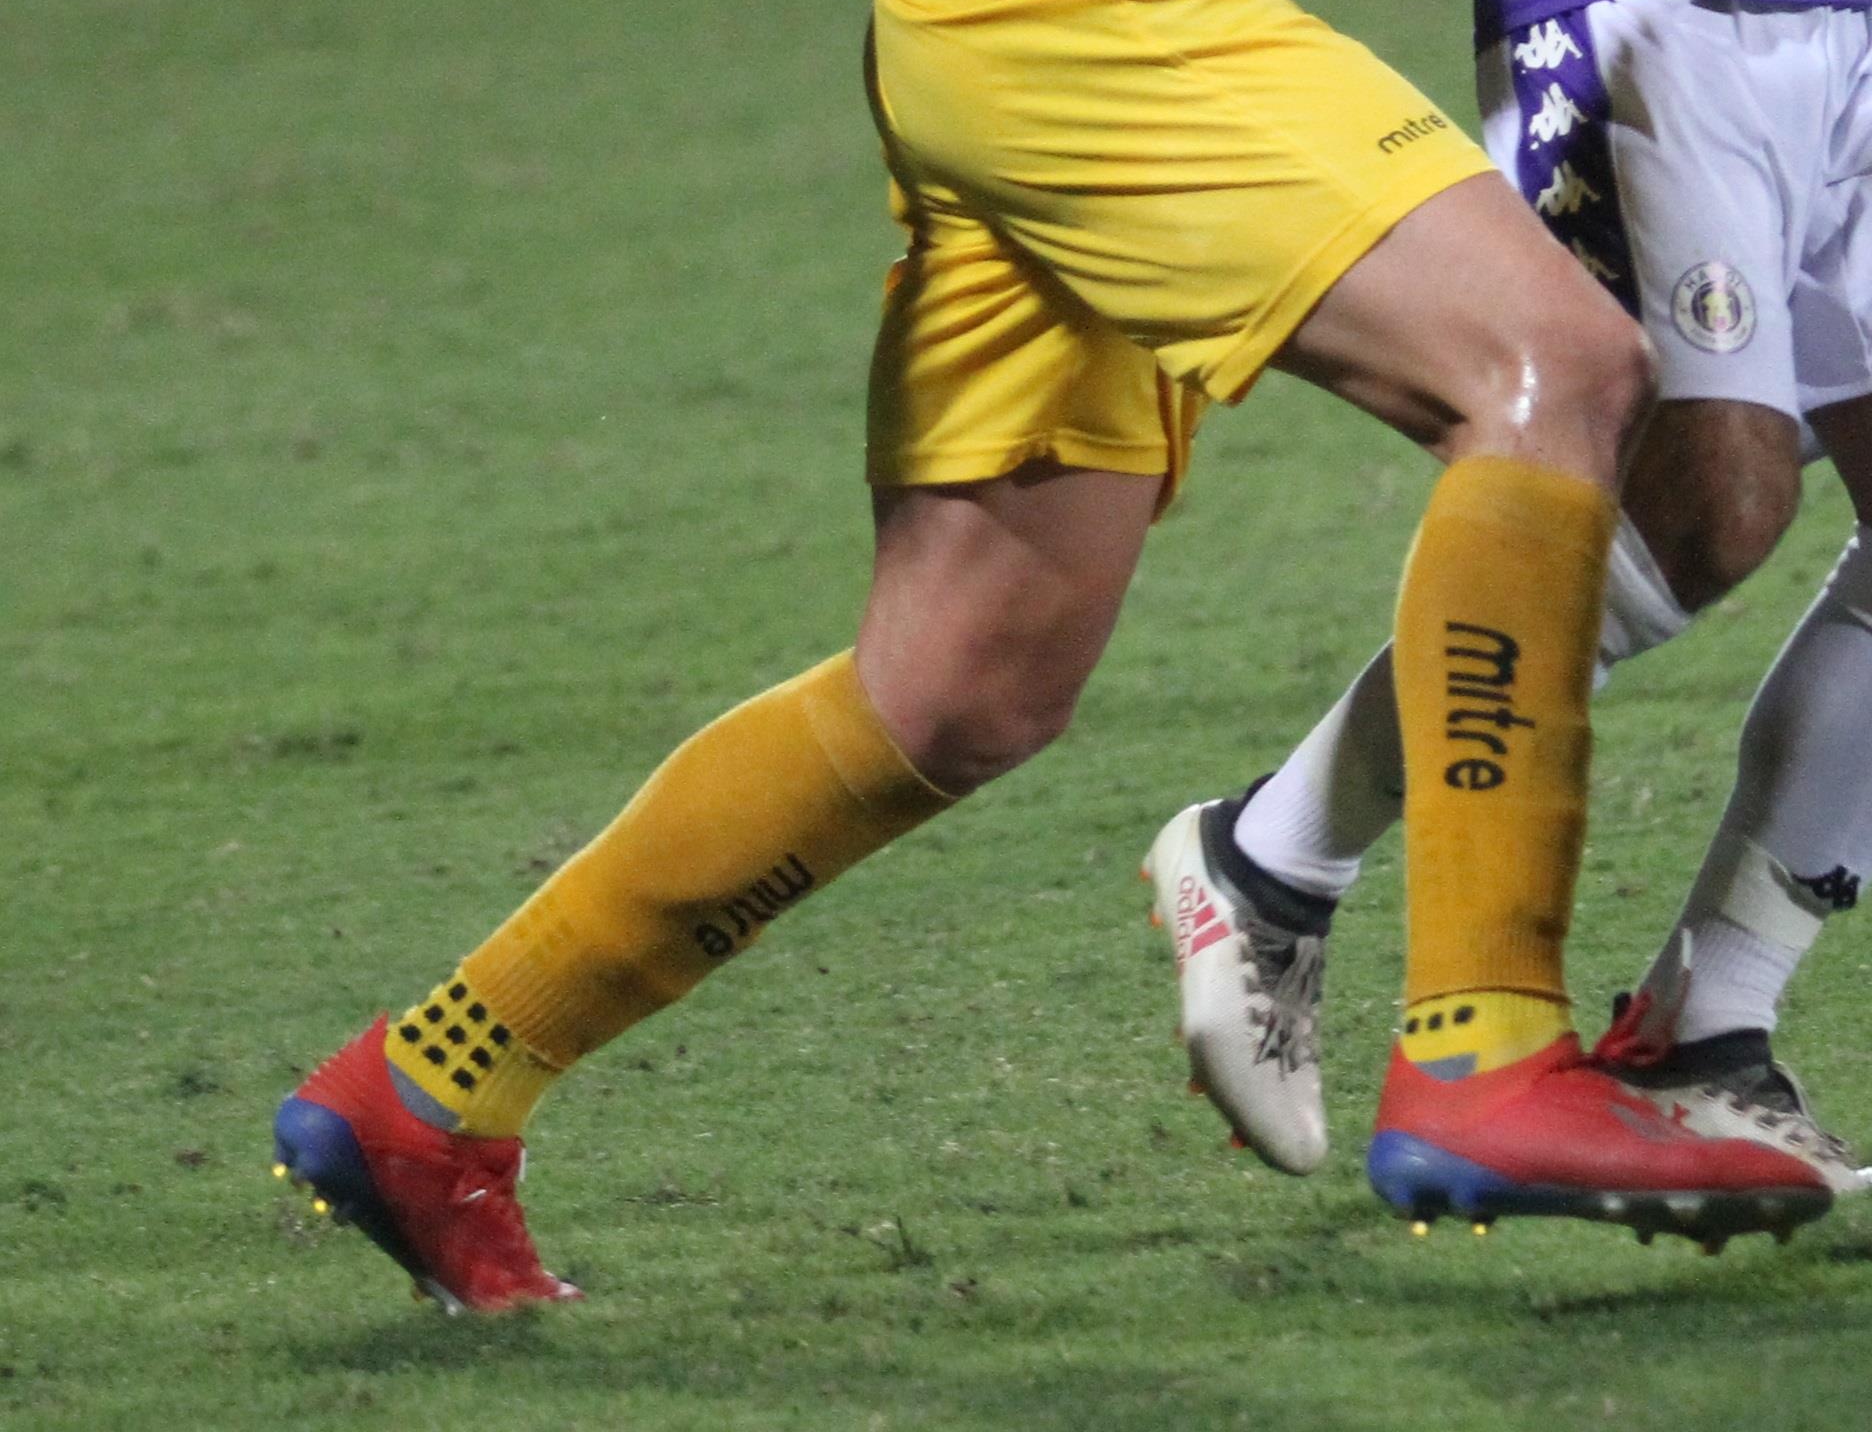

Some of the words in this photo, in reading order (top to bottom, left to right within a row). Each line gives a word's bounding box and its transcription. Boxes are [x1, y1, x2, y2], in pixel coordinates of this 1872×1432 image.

[1377, 113, 1447, 154] mitre
[1444, 621, 1536, 791] mitre
[1177, 875, 1196, 973] adid
